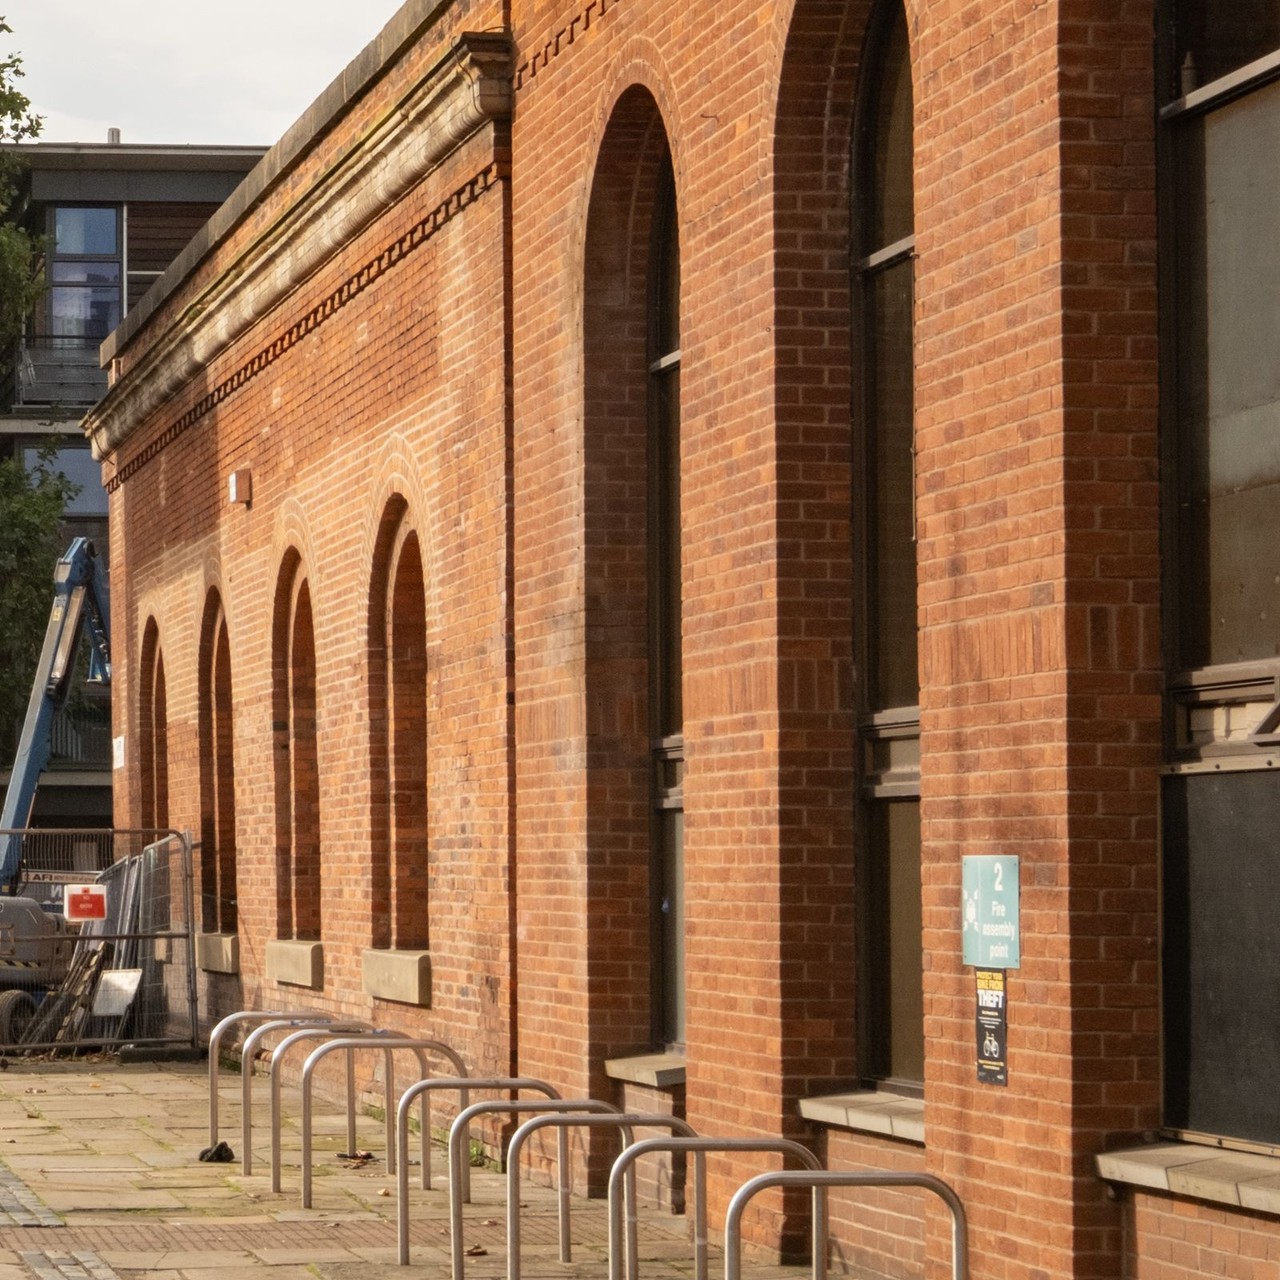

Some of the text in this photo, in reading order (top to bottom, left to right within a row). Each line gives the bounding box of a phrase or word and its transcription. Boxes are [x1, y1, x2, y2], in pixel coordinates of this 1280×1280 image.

[993, 862, 1004, 892] 2
[991, 901, 1007, 917] Fire
[982, 920, 1016, 942] assembly
[989, 942, 1009, 960] point
[977, 989, 1005, 1009] THEFT
